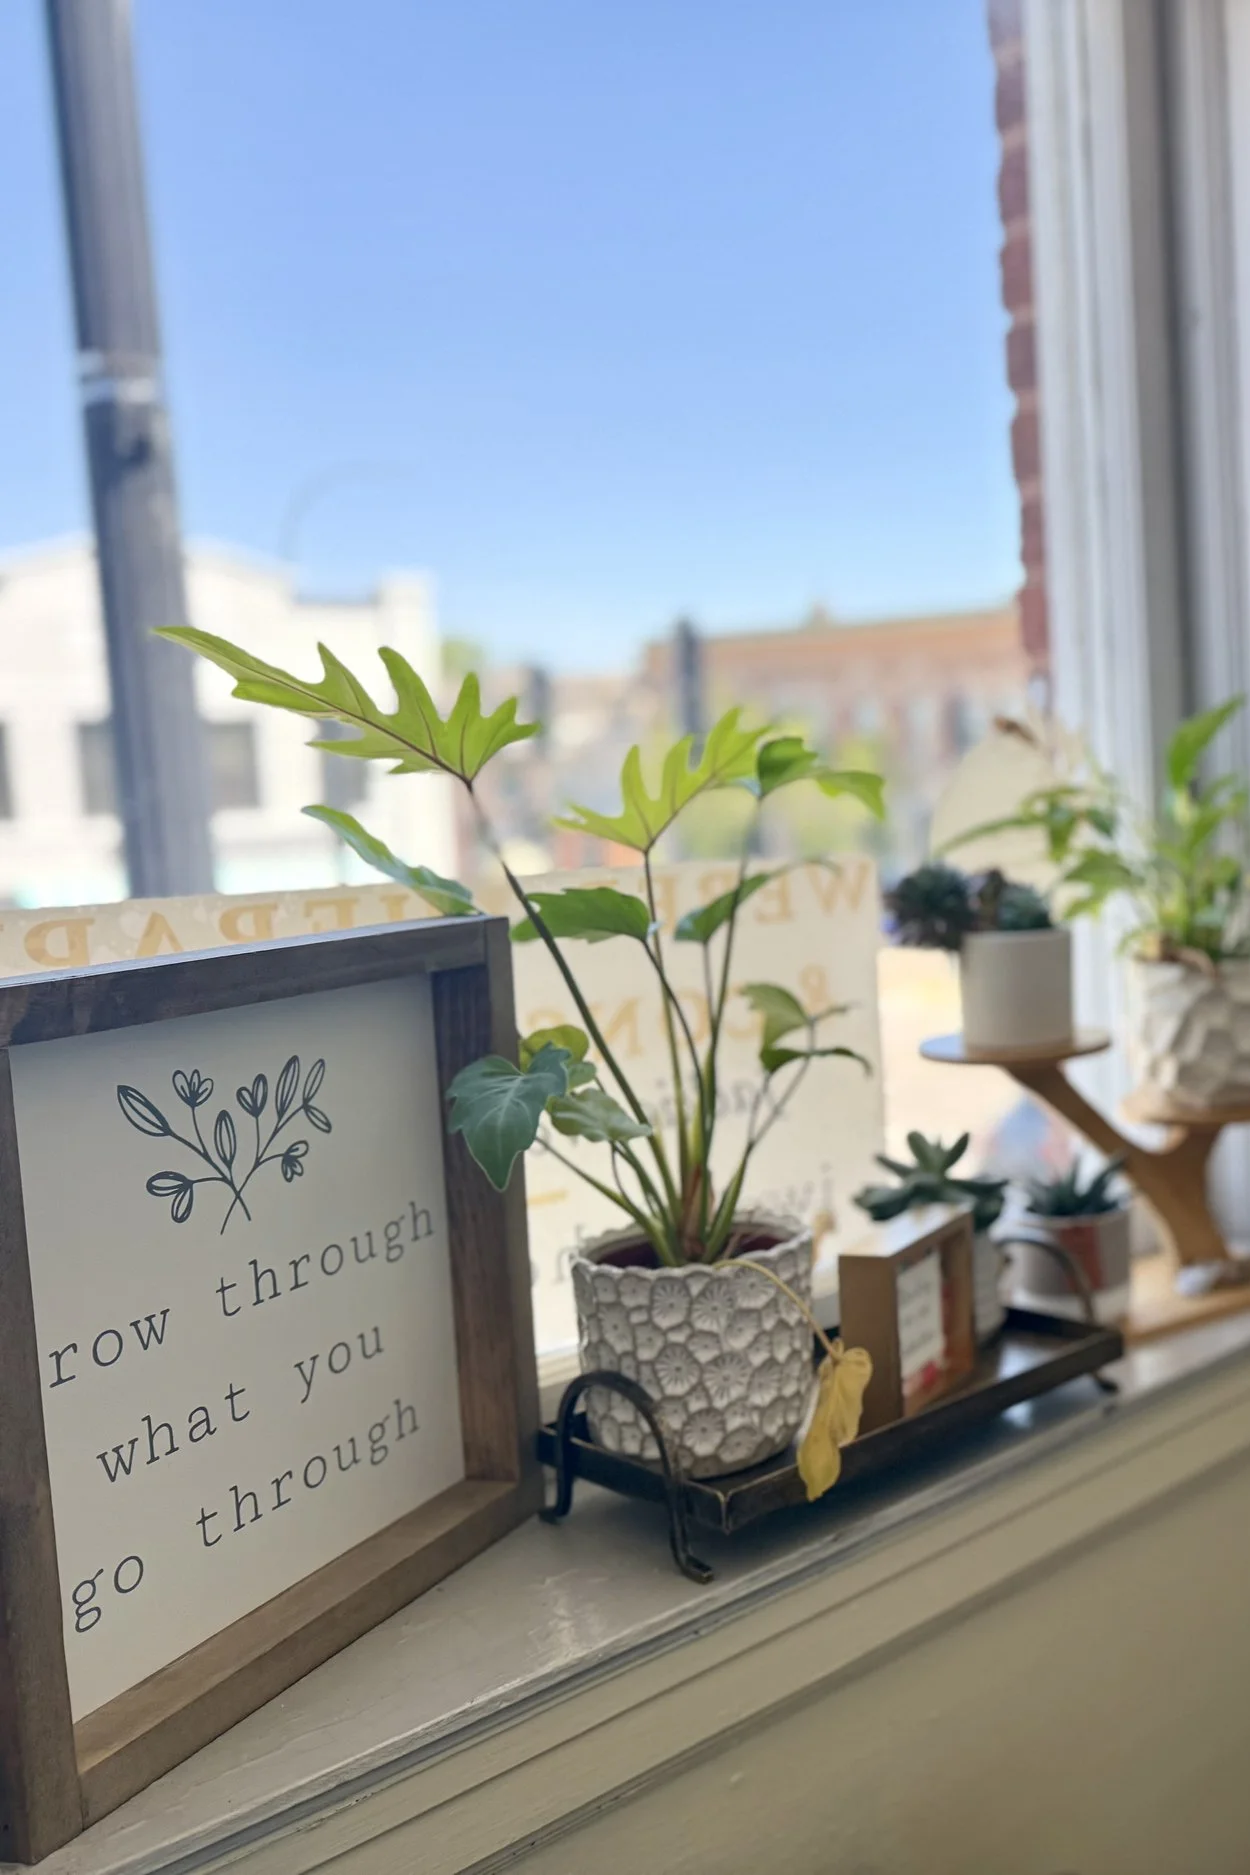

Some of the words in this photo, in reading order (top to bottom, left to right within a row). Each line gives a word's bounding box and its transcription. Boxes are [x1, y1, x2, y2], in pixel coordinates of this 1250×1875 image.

[48, 1307, 171, 1389] row
[215, 1200, 436, 1317] through
[95, 1382, 251, 1483] what
[293, 1325, 385, 1404] you
[71, 1554, 144, 1634] go
[195, 1398, 421, 1548] through
